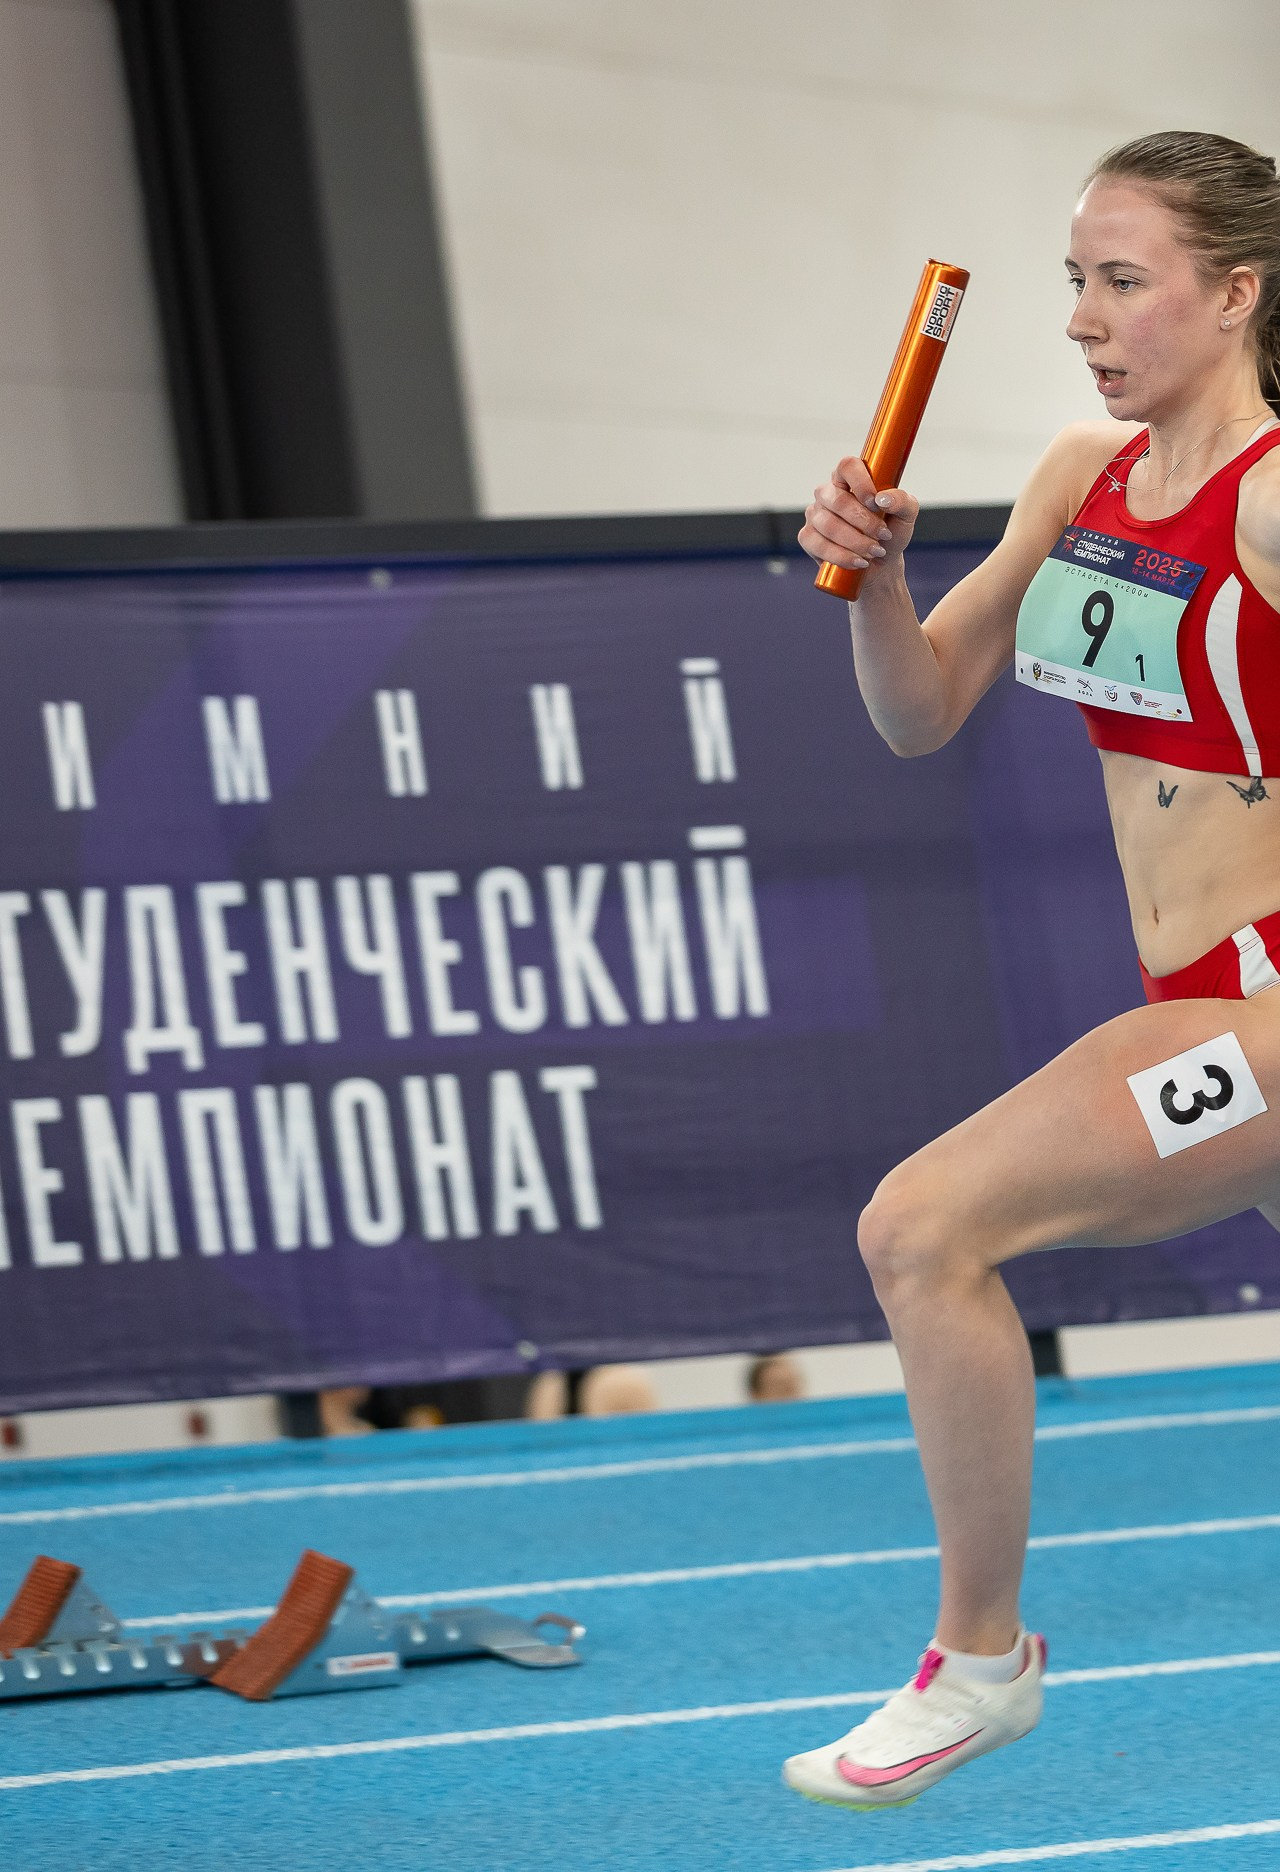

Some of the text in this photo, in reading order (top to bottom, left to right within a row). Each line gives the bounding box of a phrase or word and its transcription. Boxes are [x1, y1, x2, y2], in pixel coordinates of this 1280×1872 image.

[932, 287, 955, 338] SPORT
[1073, 547, 1112, 566] ЧЕМПИОНАТ
[1077, 540, 1126, 561] СТУДЕНЧЕСКИЙ
[1134, 549, 1185, 578] 2025
[1064, 566, 1110, 587] ЭСТАФЕТА
[1081, 589, 1115, 668] 9
[1135, 653, 1146, 683] 1
[1159, 1064, 1234, 1126] 3
[0, 1065, 603, 1271] ЕМПИОНАТ
